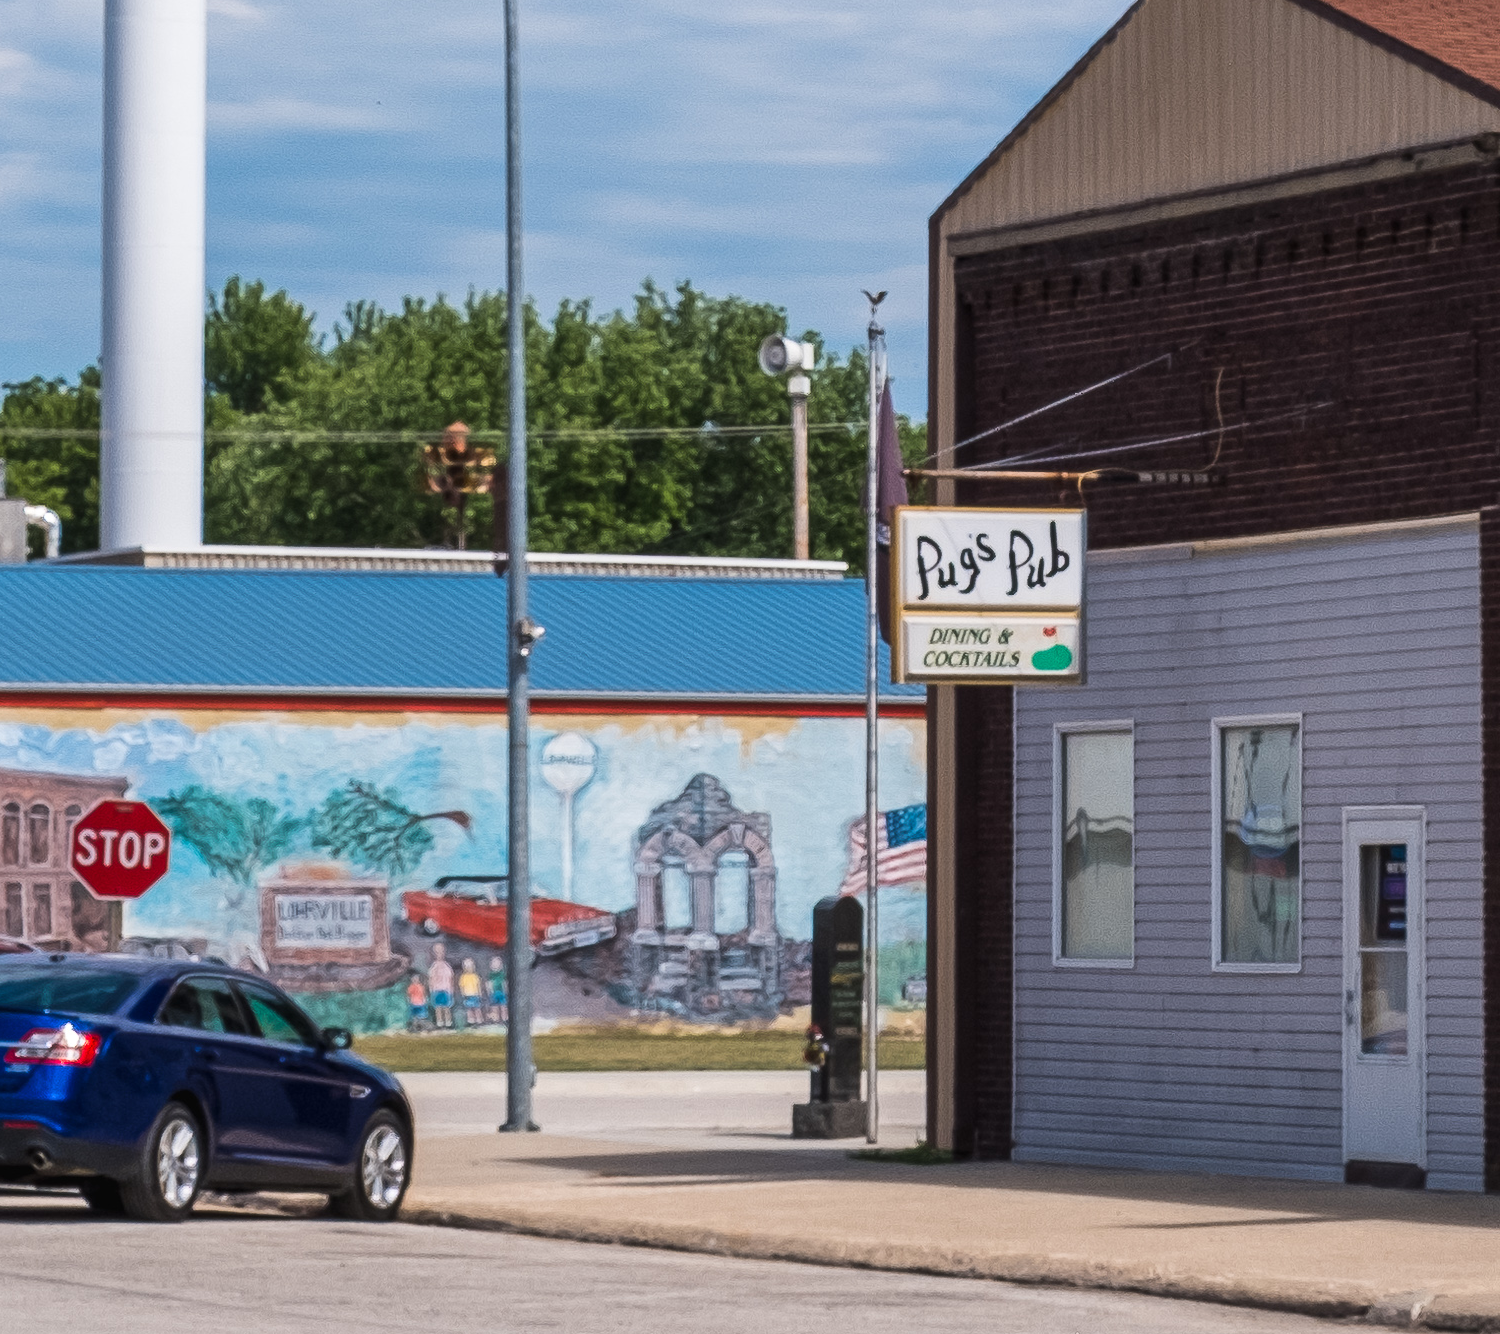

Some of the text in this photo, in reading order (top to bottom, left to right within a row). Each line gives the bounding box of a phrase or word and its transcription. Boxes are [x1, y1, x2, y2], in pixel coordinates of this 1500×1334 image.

[916, 520, 1071, 601] Pug's Pub
[928, 627, 1014, 645] DINING &
[922, 650, 1022, 668] COCKTAILS
[75, 828, 166, 870] STOP
